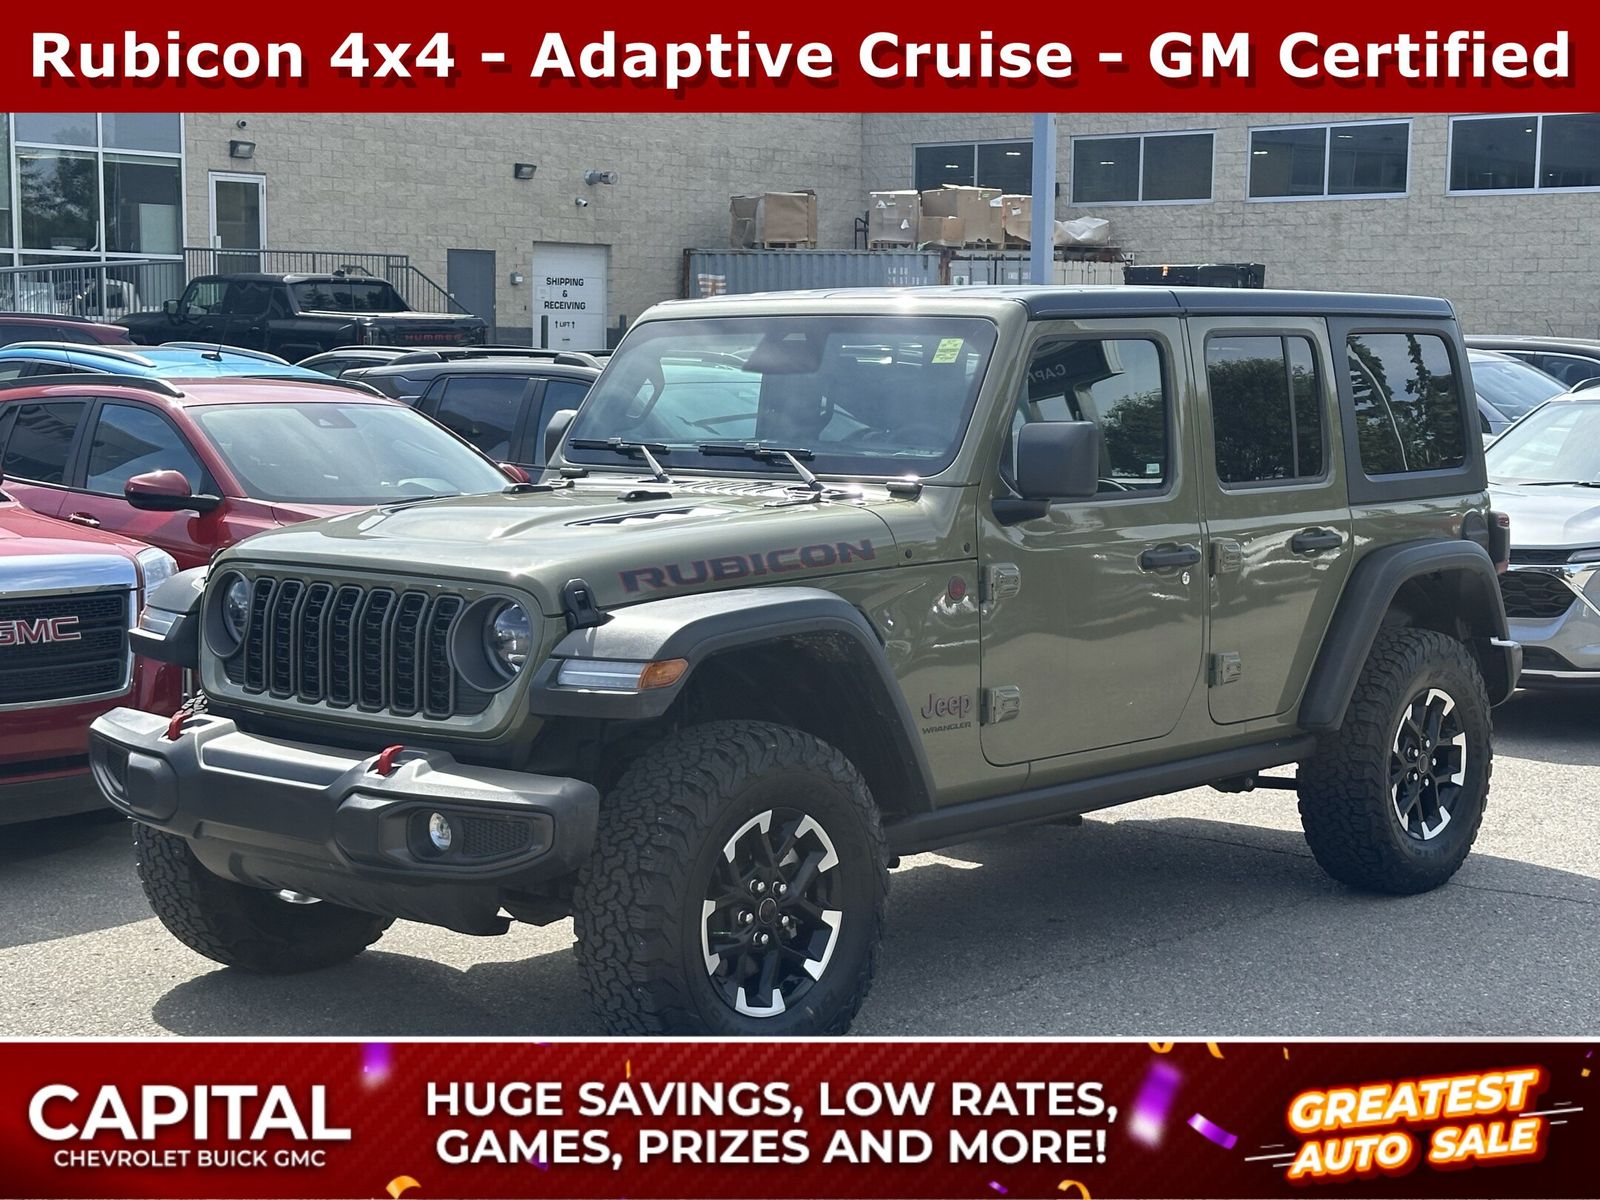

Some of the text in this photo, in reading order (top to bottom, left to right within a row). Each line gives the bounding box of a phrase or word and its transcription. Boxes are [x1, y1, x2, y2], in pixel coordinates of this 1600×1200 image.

[546, 277, 584, 287] SHIPPING
[562, 290, 568, 298] &
[544, 301, 586, 310] RECEIVING
[618, 539, 876, 593] RUBICON
[921, 693, 970, 719] Jeep
[922, 721, 972, 734] WRANGLER
